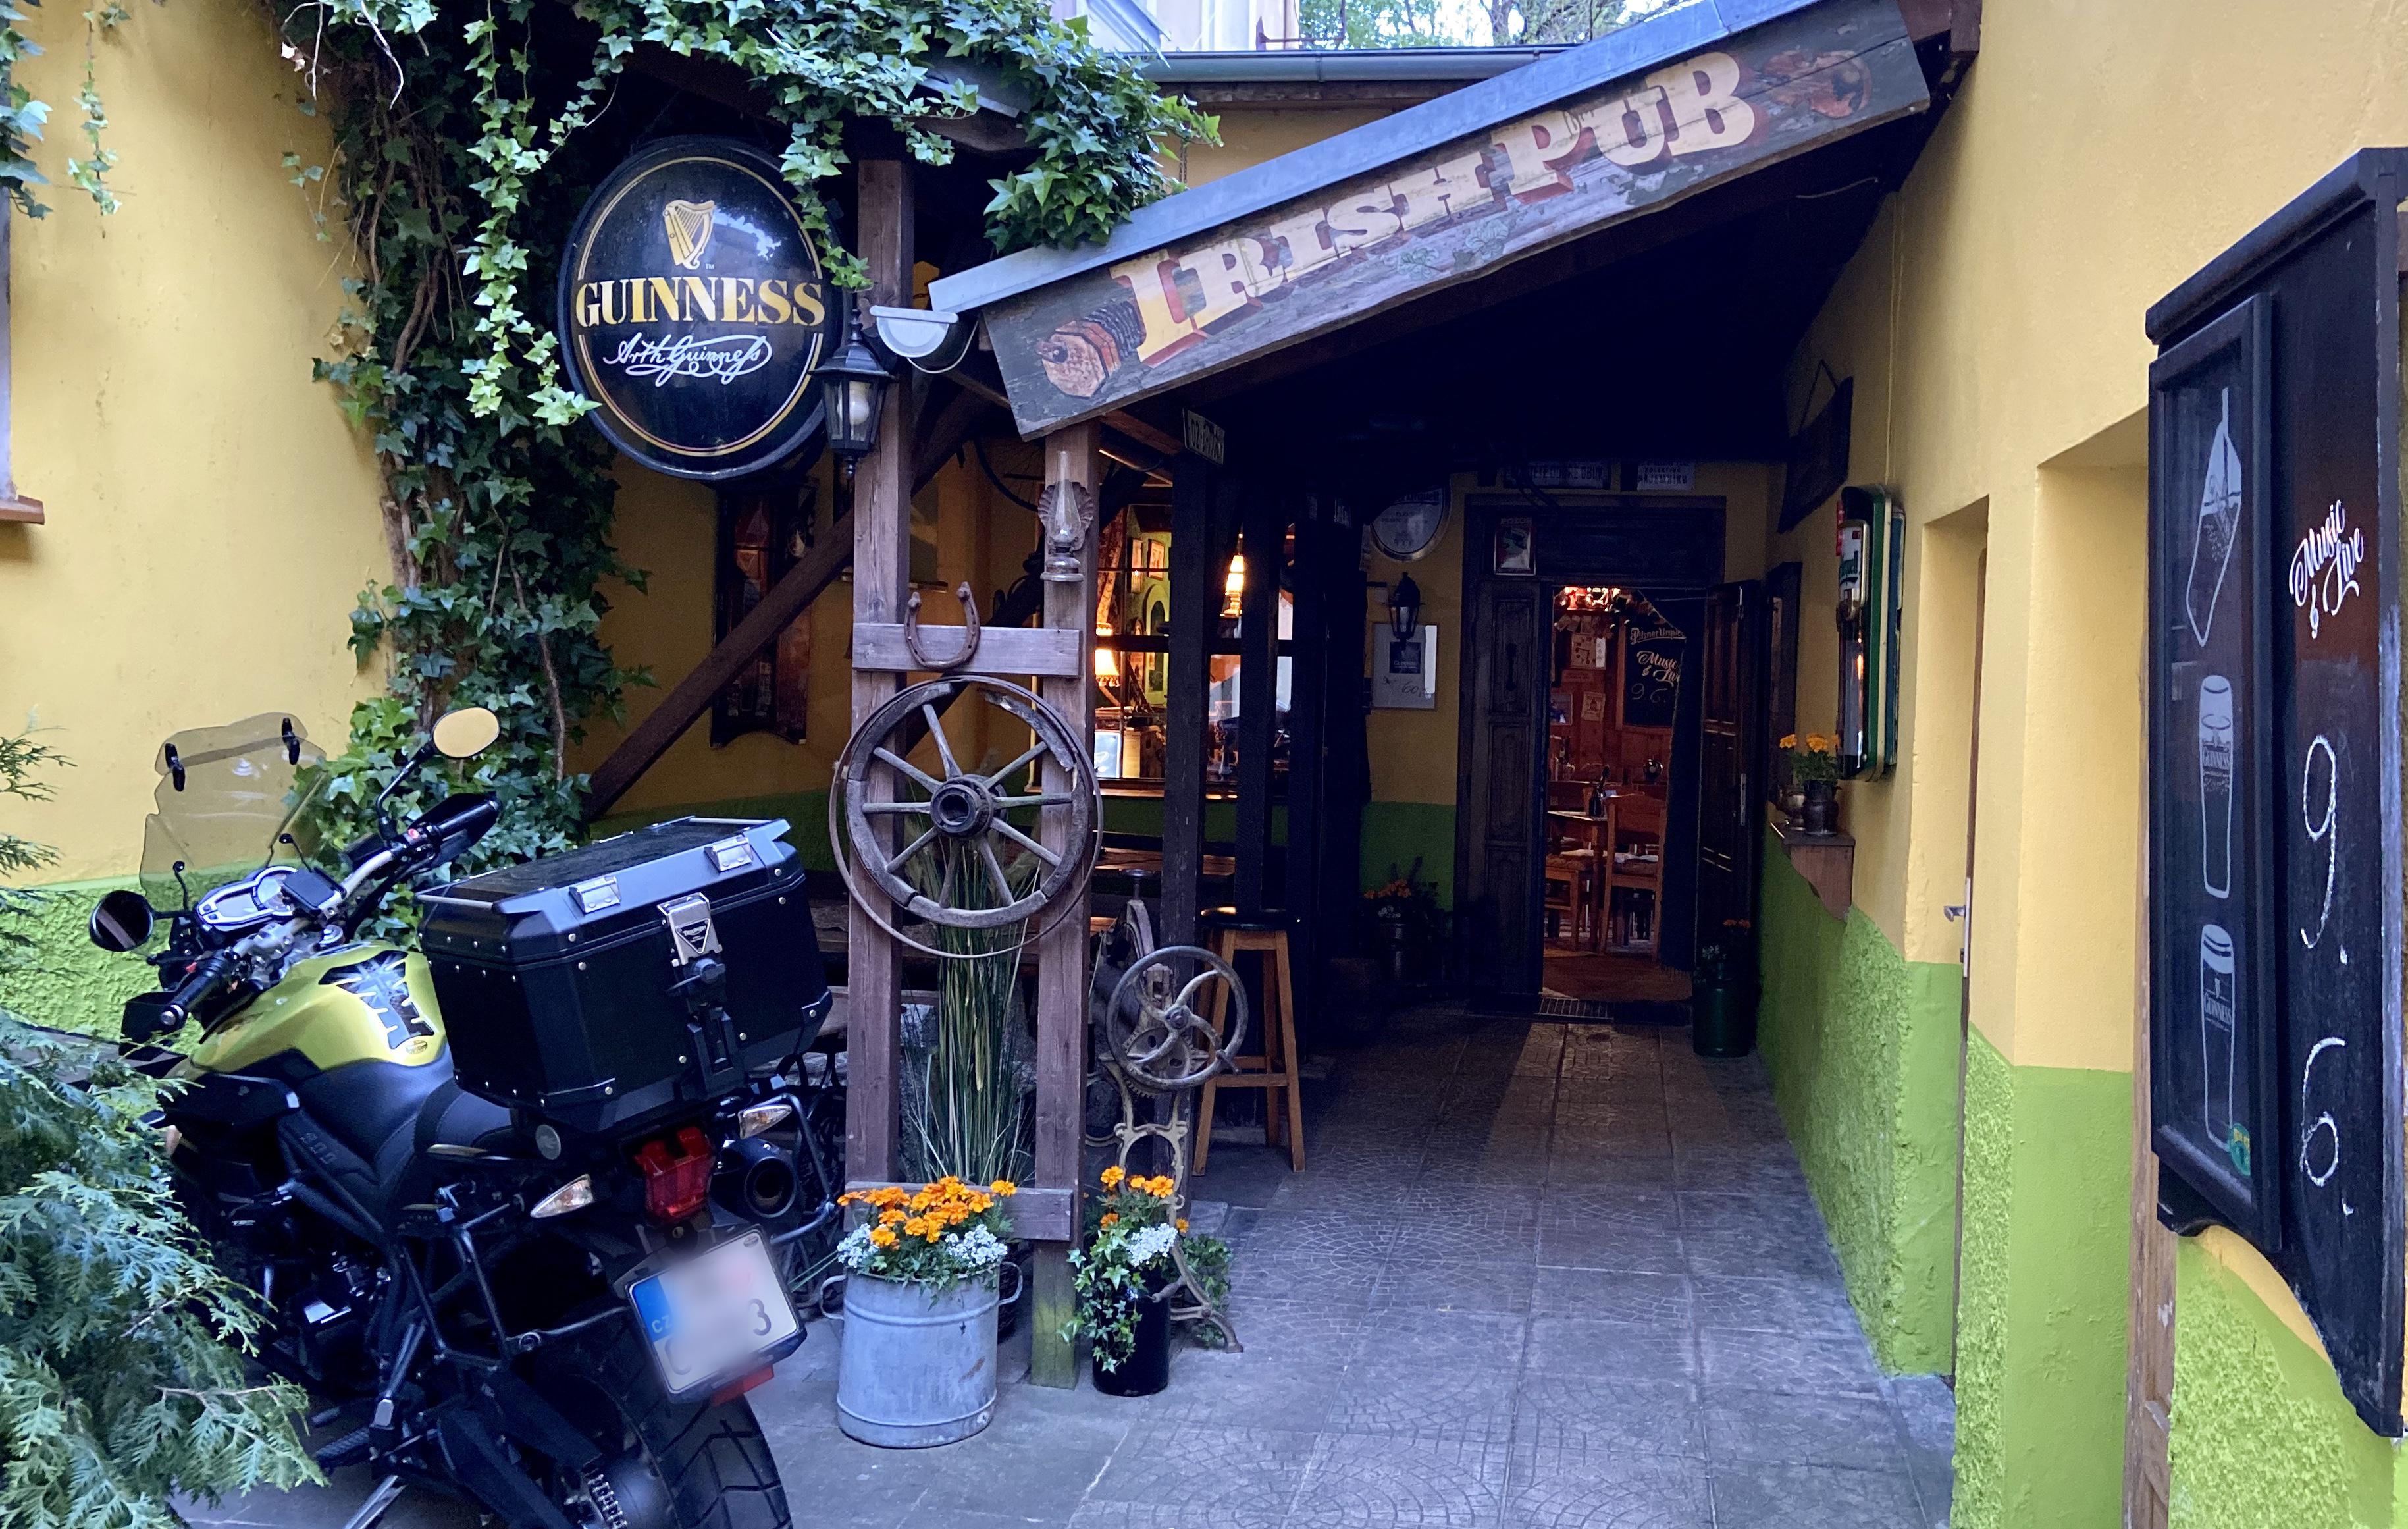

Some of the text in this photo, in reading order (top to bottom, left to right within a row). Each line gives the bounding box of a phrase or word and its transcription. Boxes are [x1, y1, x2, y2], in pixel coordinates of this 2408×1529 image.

[1109, 51, 1755, 363] IRISH PUB
[575, 276, 825, 327] GUINNESS
[2289, 499, 2345, 607] Music
[2322, 527, 2364, 616] Live
